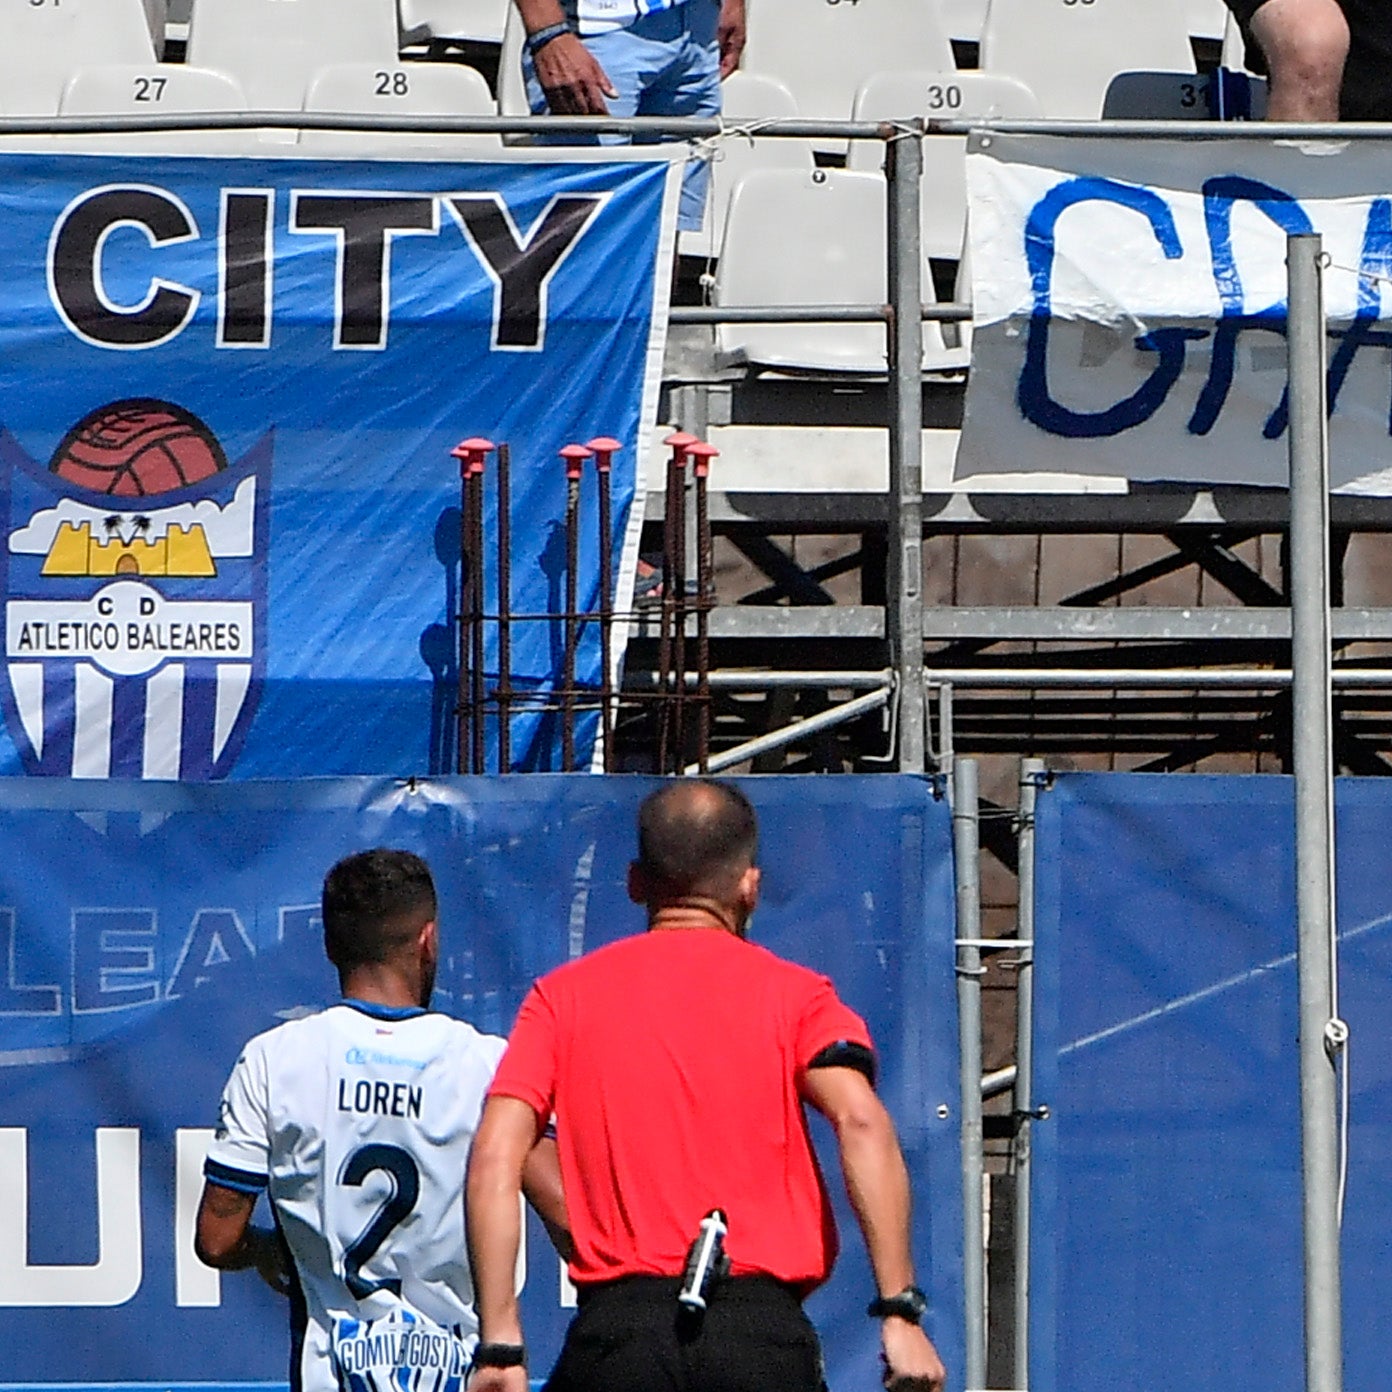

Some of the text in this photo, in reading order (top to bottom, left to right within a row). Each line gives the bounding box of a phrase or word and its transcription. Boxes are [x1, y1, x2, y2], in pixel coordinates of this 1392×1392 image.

[134, 78, 168, 101] 27
[374, 72, 408, 96] 28
[928, 85, 962, 110] 30
[46, 183, 616, 352] CITY
[98, 597, 156, 617] C D
[17, 621, 241, 652] ATLETICO BALEARES
[338, 1078, 423, 1119] LOREN
[336, 1142, 422, 1301] 2
